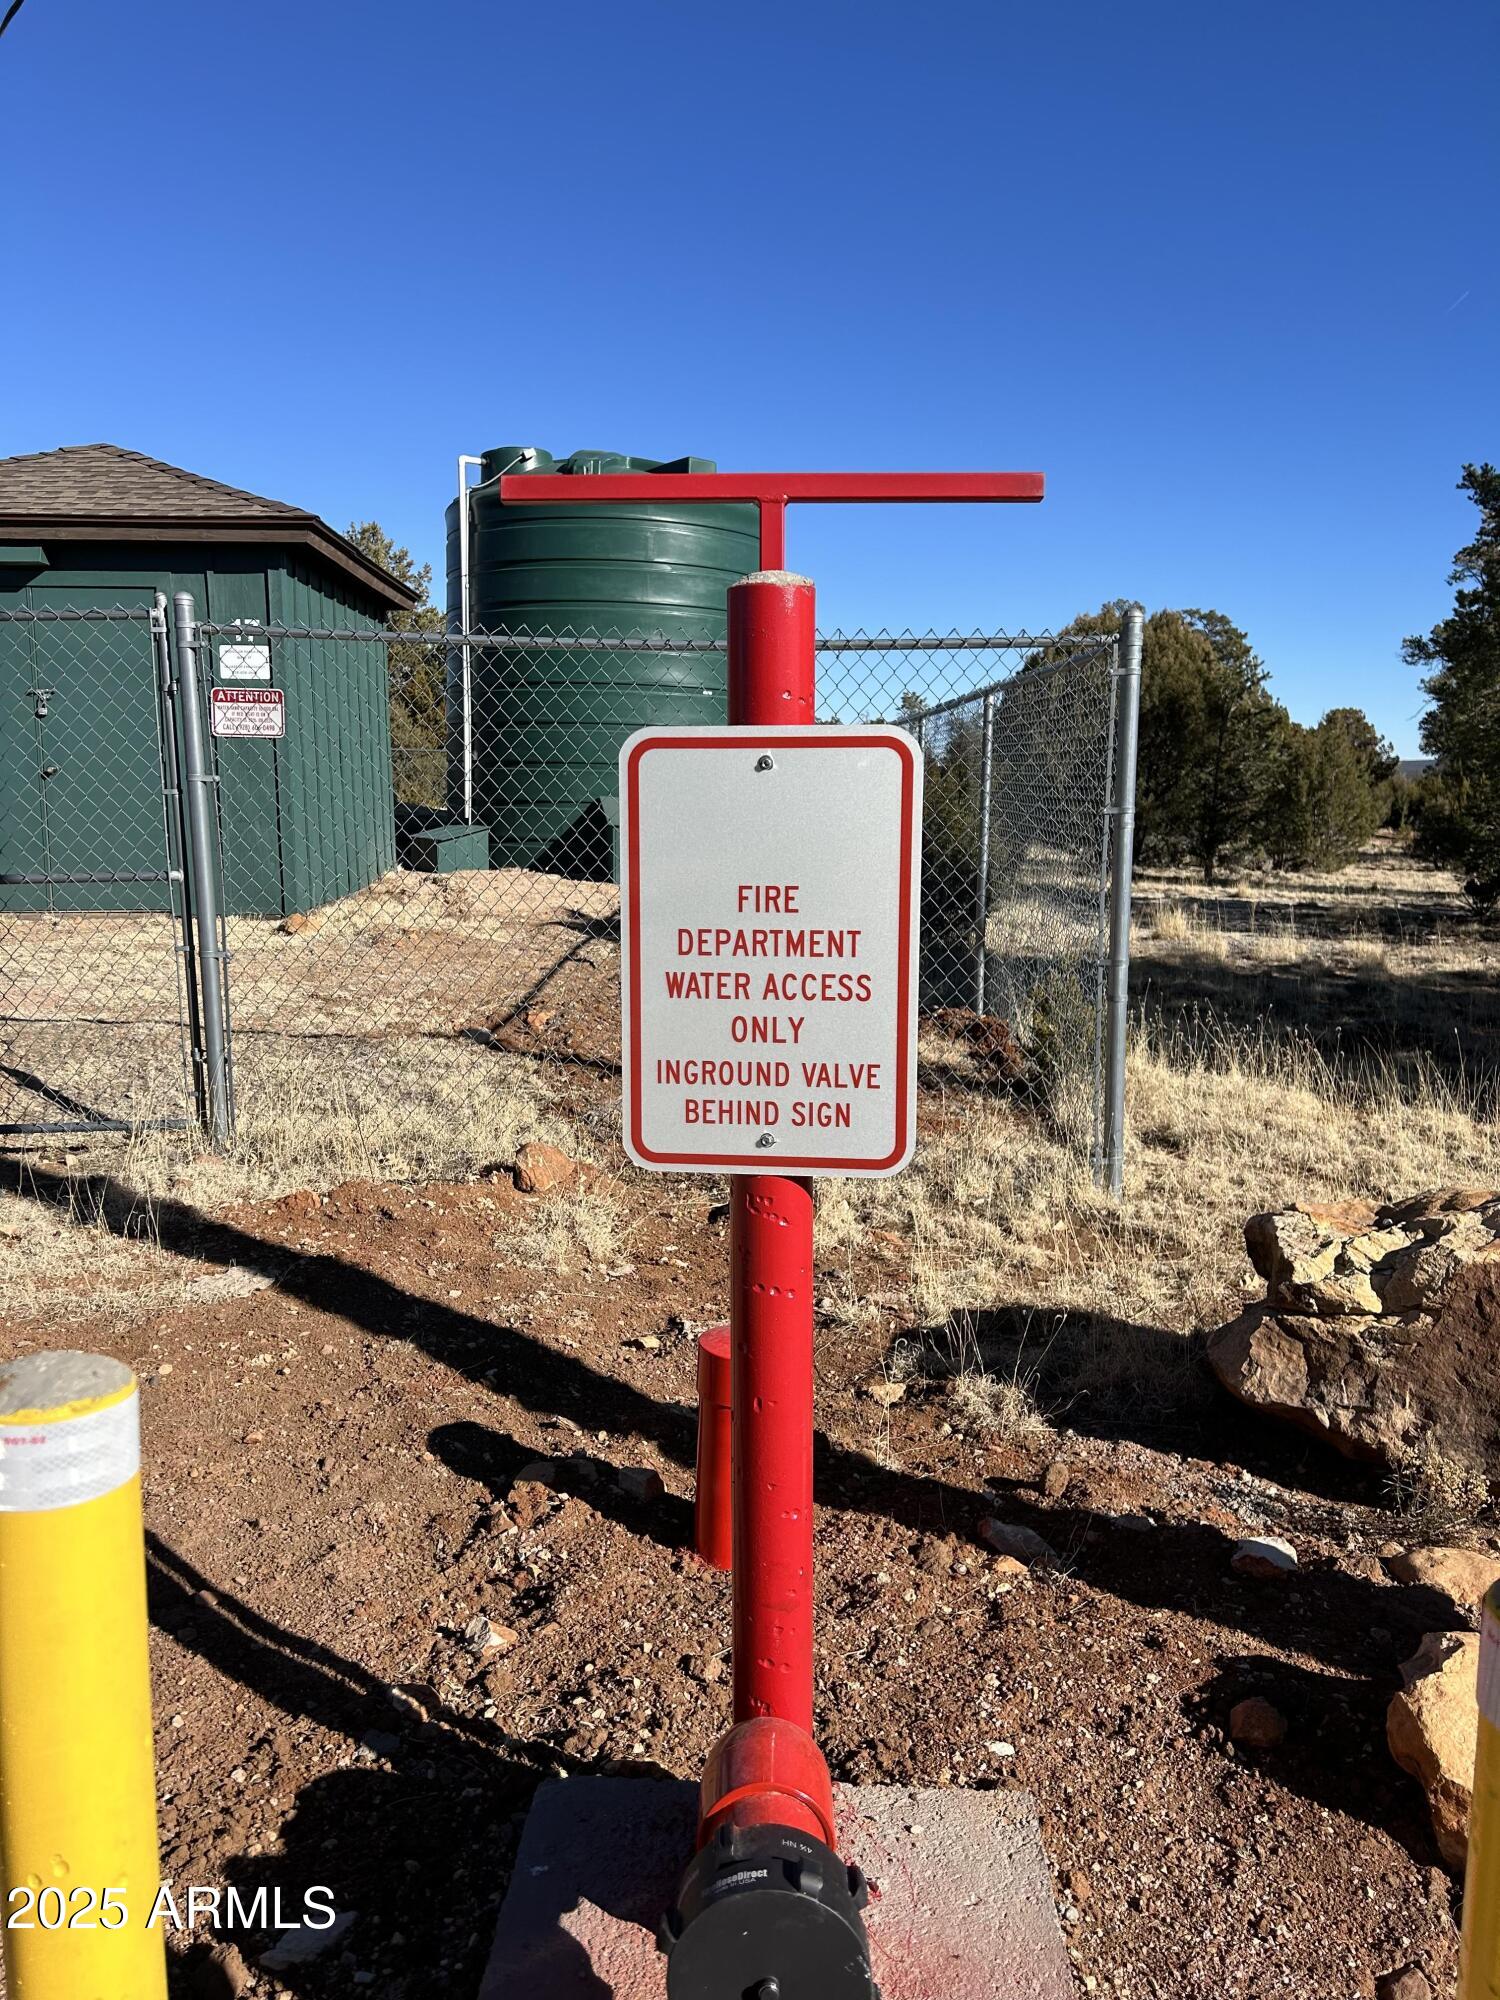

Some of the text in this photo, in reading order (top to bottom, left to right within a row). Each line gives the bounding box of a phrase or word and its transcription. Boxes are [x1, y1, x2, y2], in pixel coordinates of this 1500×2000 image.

[217, 690, 279, 703] ATTENTION
[222, 723, 235, 731] CALL
[738, 885, 799, 913] FIRE
[677, 929, 861, 957] DEPARTMENT
[665, 972, 872, 1002] WATER ACCESS
[731, 1015, 805, 1044] ONLY
[657, 1060, 881, 1089] INGROUND VALVE
[685, 1099, 850, 1127] BEHIND SIGN
